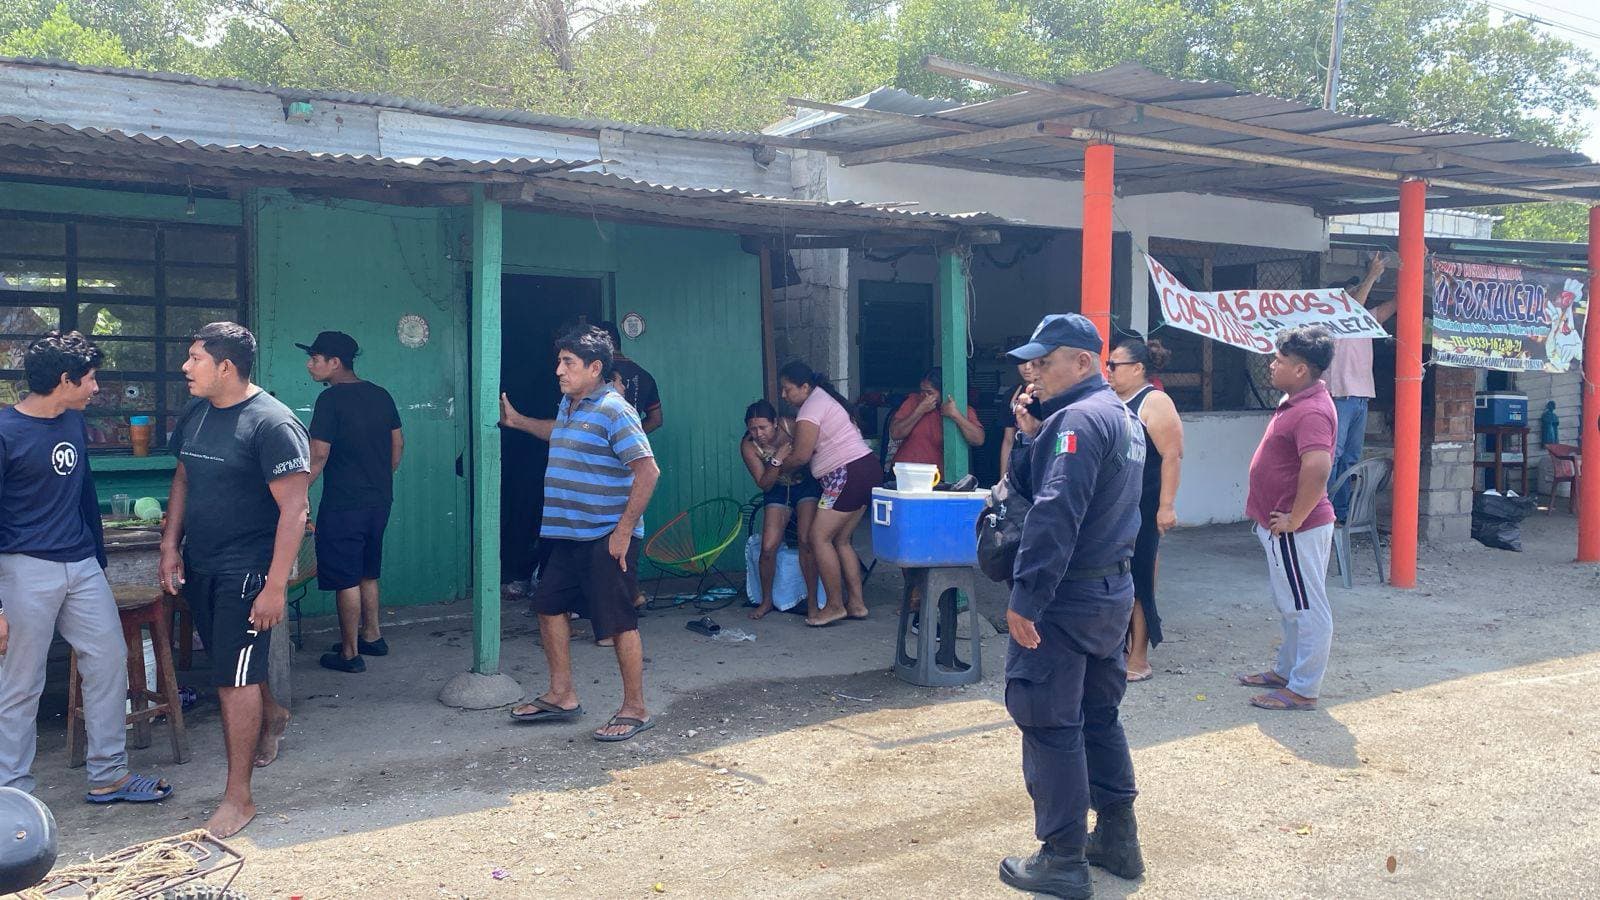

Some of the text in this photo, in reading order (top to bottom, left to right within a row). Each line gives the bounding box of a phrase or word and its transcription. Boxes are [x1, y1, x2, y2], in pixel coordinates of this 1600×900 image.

[1454, 279, 1548, 324] FORTALEZA
[1261, 318, 1286, 330] LA
[56, 448, 75, 469] 90
